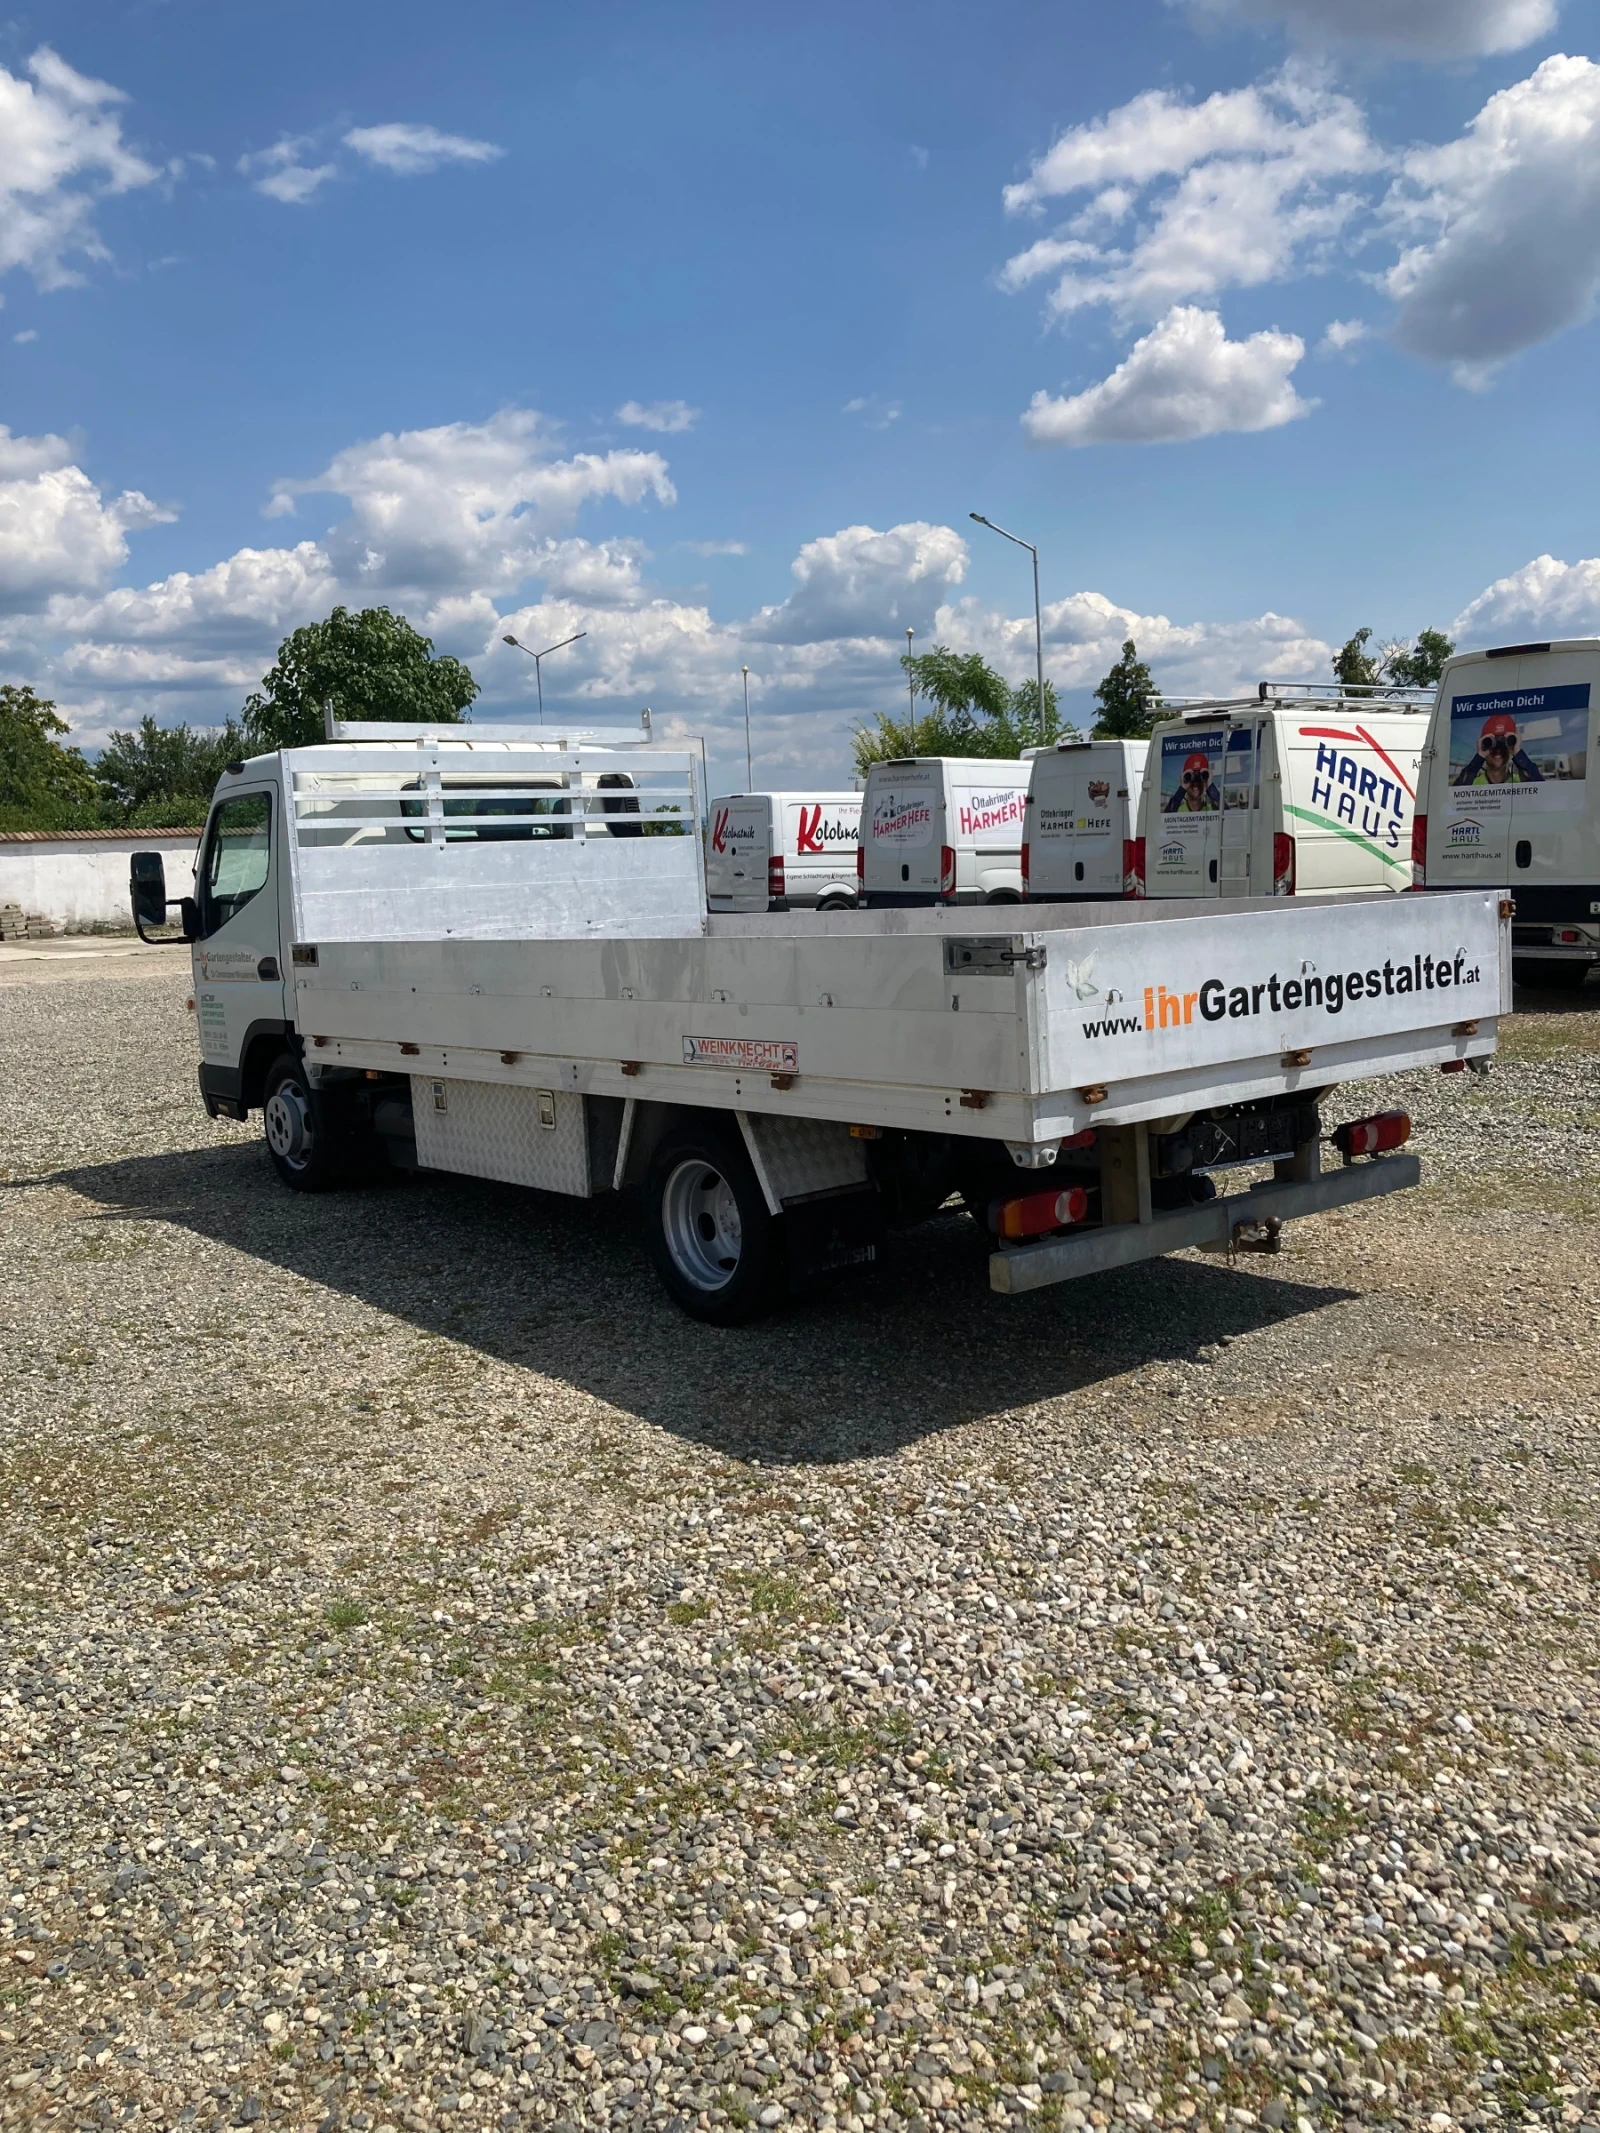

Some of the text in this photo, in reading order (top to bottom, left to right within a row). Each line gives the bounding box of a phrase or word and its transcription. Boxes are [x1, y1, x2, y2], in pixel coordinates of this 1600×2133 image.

[1456, 695, 1545, 712] Wir suchen Dich!
[1164, 741, 1178, 751] Wir
[1179, 739, 1207, 750] suchen
[1315, 741, 1405, 820] HARTL
[1453, 787, 1539, 799] MONTAGEMITARBEITER
[971, 790, 1015, 811] Ottakringer
[1311, 775, 1402, 848] HAUS
[1040, 818, 1111, 831] HARMER HEFE
[1164, 815, 1220, 824] MONTAGEMITARBEIT
[797, 804, 860, 852] Kolobra
[1452, 826, 1480, 835] HARTL
[1451, 835, 1480, 843] HAUS
[1162, 847, 1184, 855] HARTL
[1442, 852, 1502, 860] www.hartlhaus.at
[1162, 854, 1184, 862] HAUS
[697, 1039, 781, 1059] WEINKNECHT
